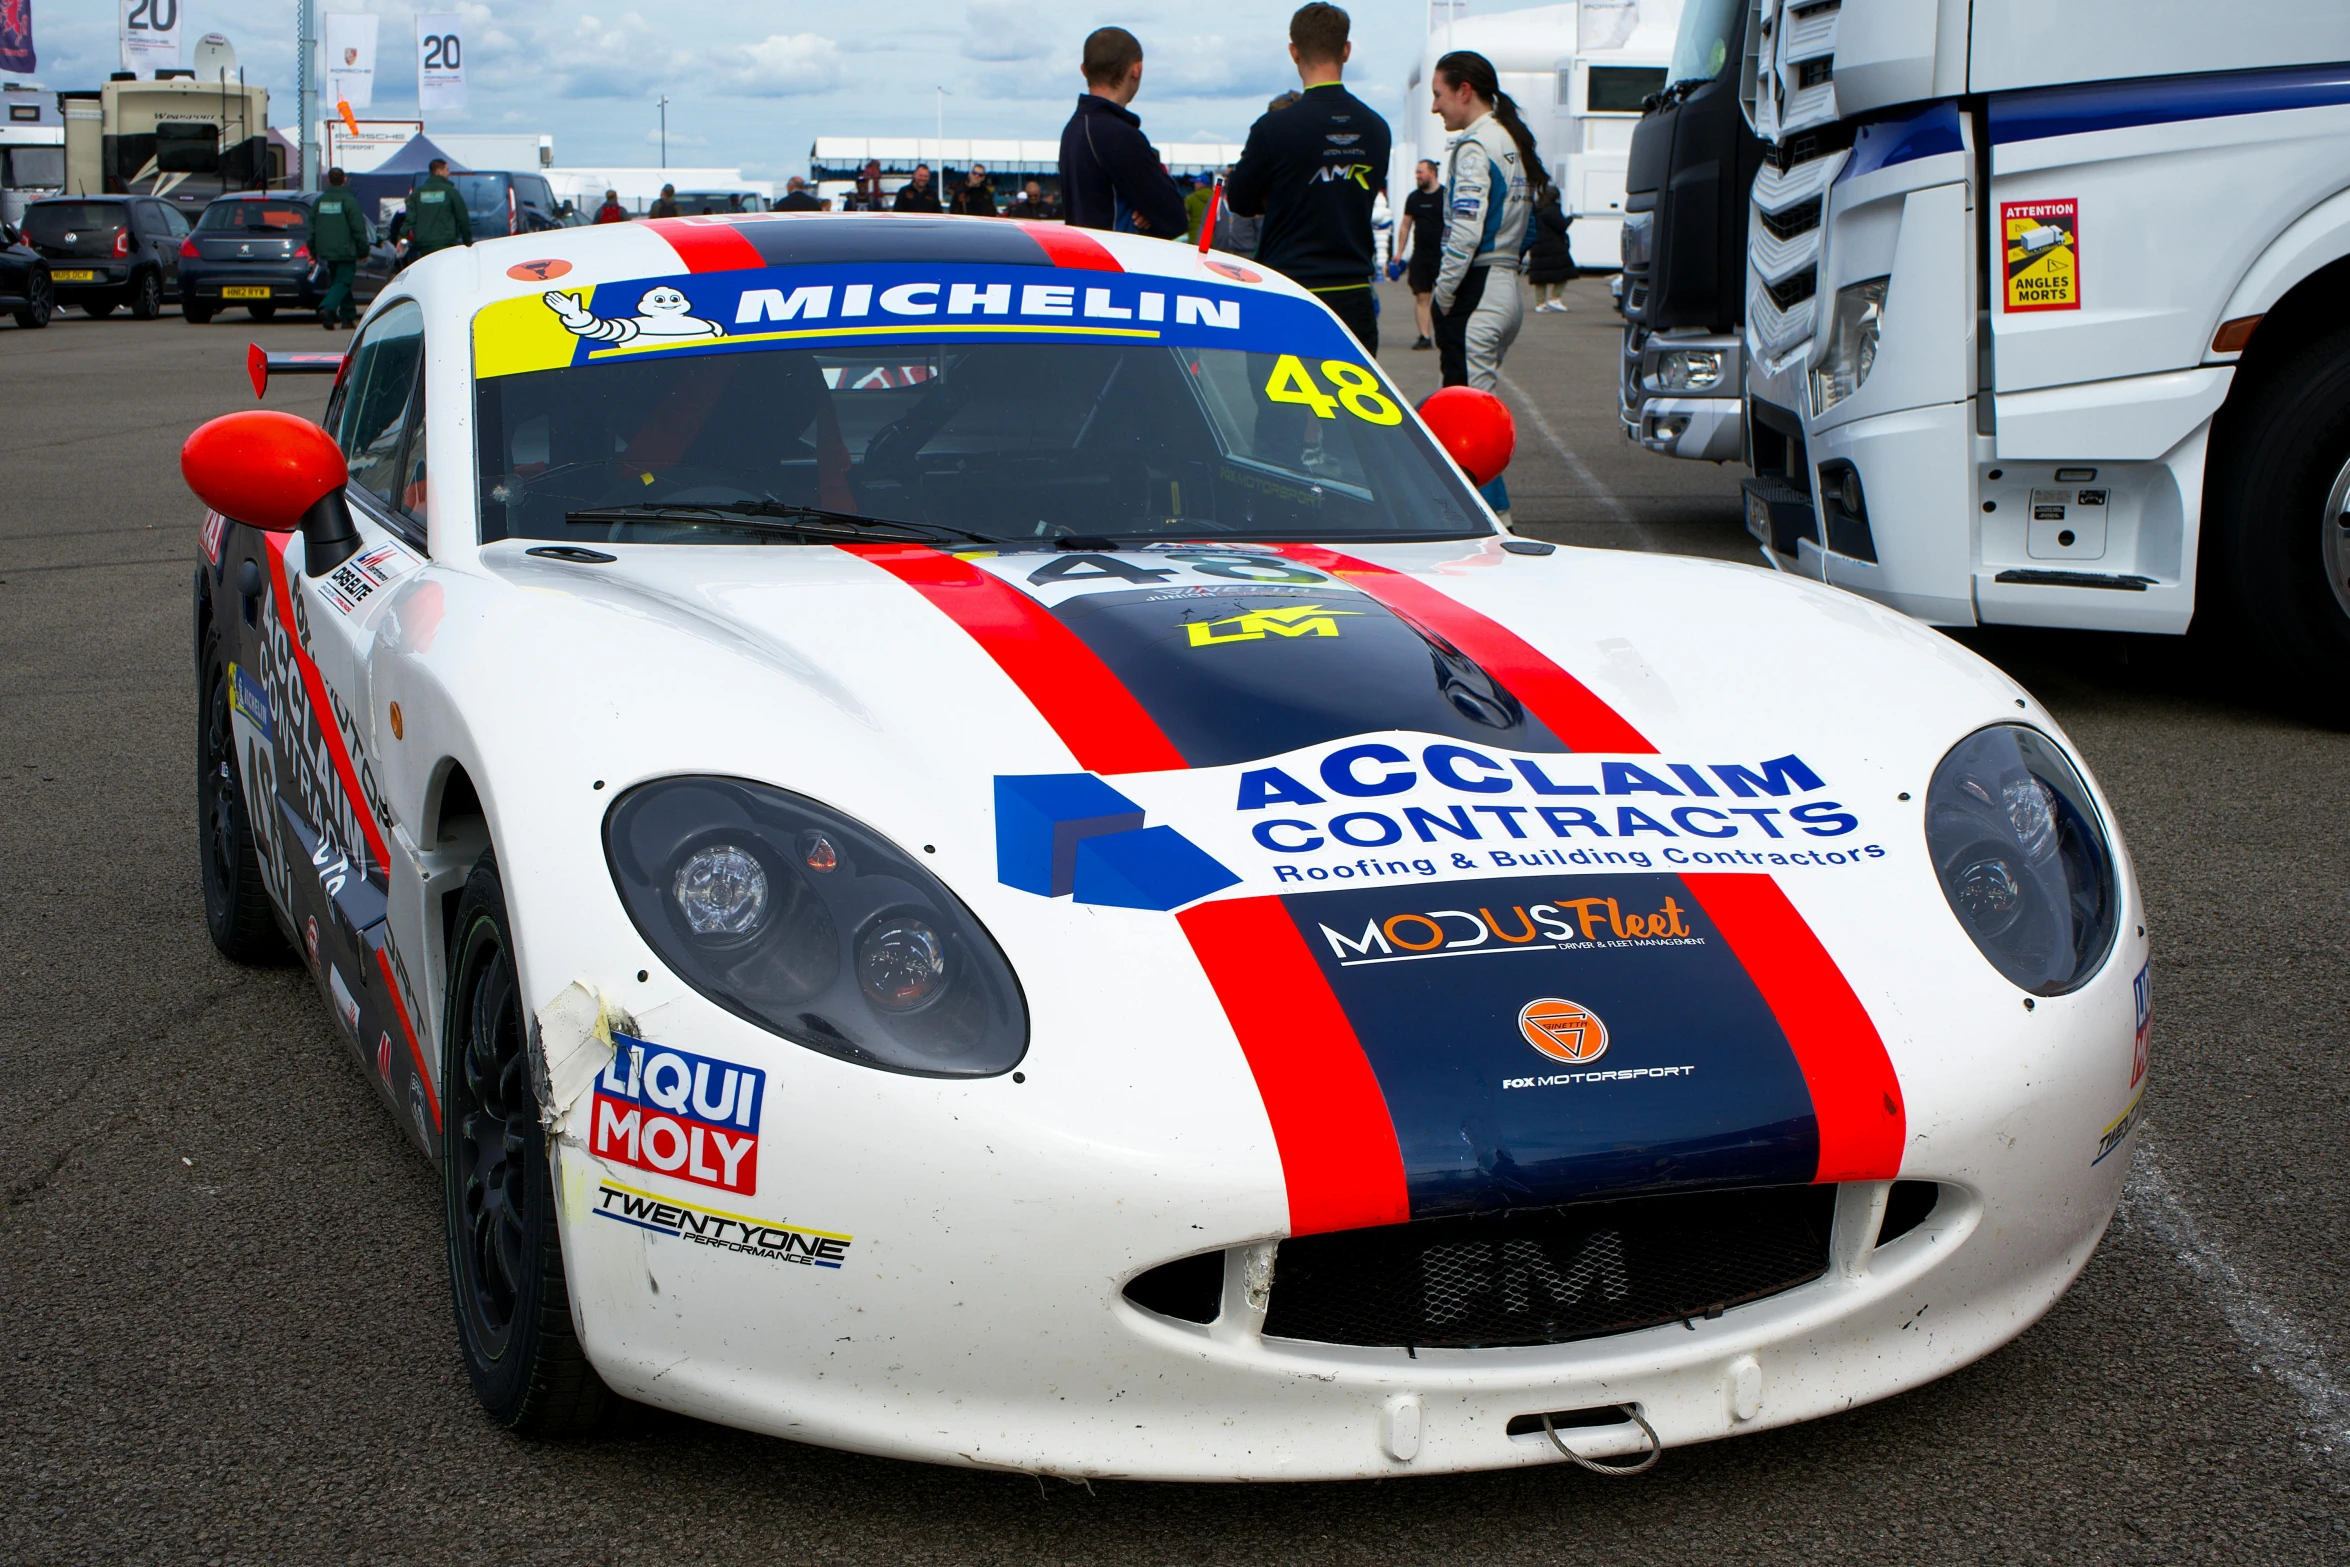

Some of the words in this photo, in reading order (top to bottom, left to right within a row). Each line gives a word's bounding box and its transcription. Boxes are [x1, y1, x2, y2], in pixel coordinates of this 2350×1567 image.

[423, 34, 460, 69] 20
[1308, 164, 1373, 190] AMR
[2006, 204, 2074, 218] ATTENTION
[227, 288, 246, 296] HN12
[2016, 276, 2069, 290] ANGLES
[2019, 289, 2067, 302] MORTS
[734, 283, 1241, 330] MICHELIN
[1265, 354, 1402, 426] 48
[1026, 553, 1329, 587] 48
[1146, 592, 1215, 602] JUNIOR
[263, 581, 367, 882] ACCLAIM
[1236, 743, 1826, 811] ACCLAIM
[1251, 800, 1859, 854] CONTRACTS
[1273, 857, 1435, 885] Roofing
[1452, 851, 1479, 870] &
[1491, 846, 1653, 868] Building
[1662, 842, 1885, 867] Contractors
[1559, 941, 1593, 950] DRIVER
[1597, 940, 1606, 949] &
[1607, 939, 1633, 948] FLEET
[1634, 937, 1706, 947] MANAGEMENT
[602, 1043, 757, 1128] LIQUI
[1503, 1076, 1535, 1089] FOX
[1537, 1065, 1694, 1086] MOTORSPORT
[596, 1100, 756, 1187] MOLY
[599, 1186, 852, 1261] TWENTYONE
[683, 1231, 815, 1266] PERFORMANCE
[1422, 1229, 1629, 1324] FM
